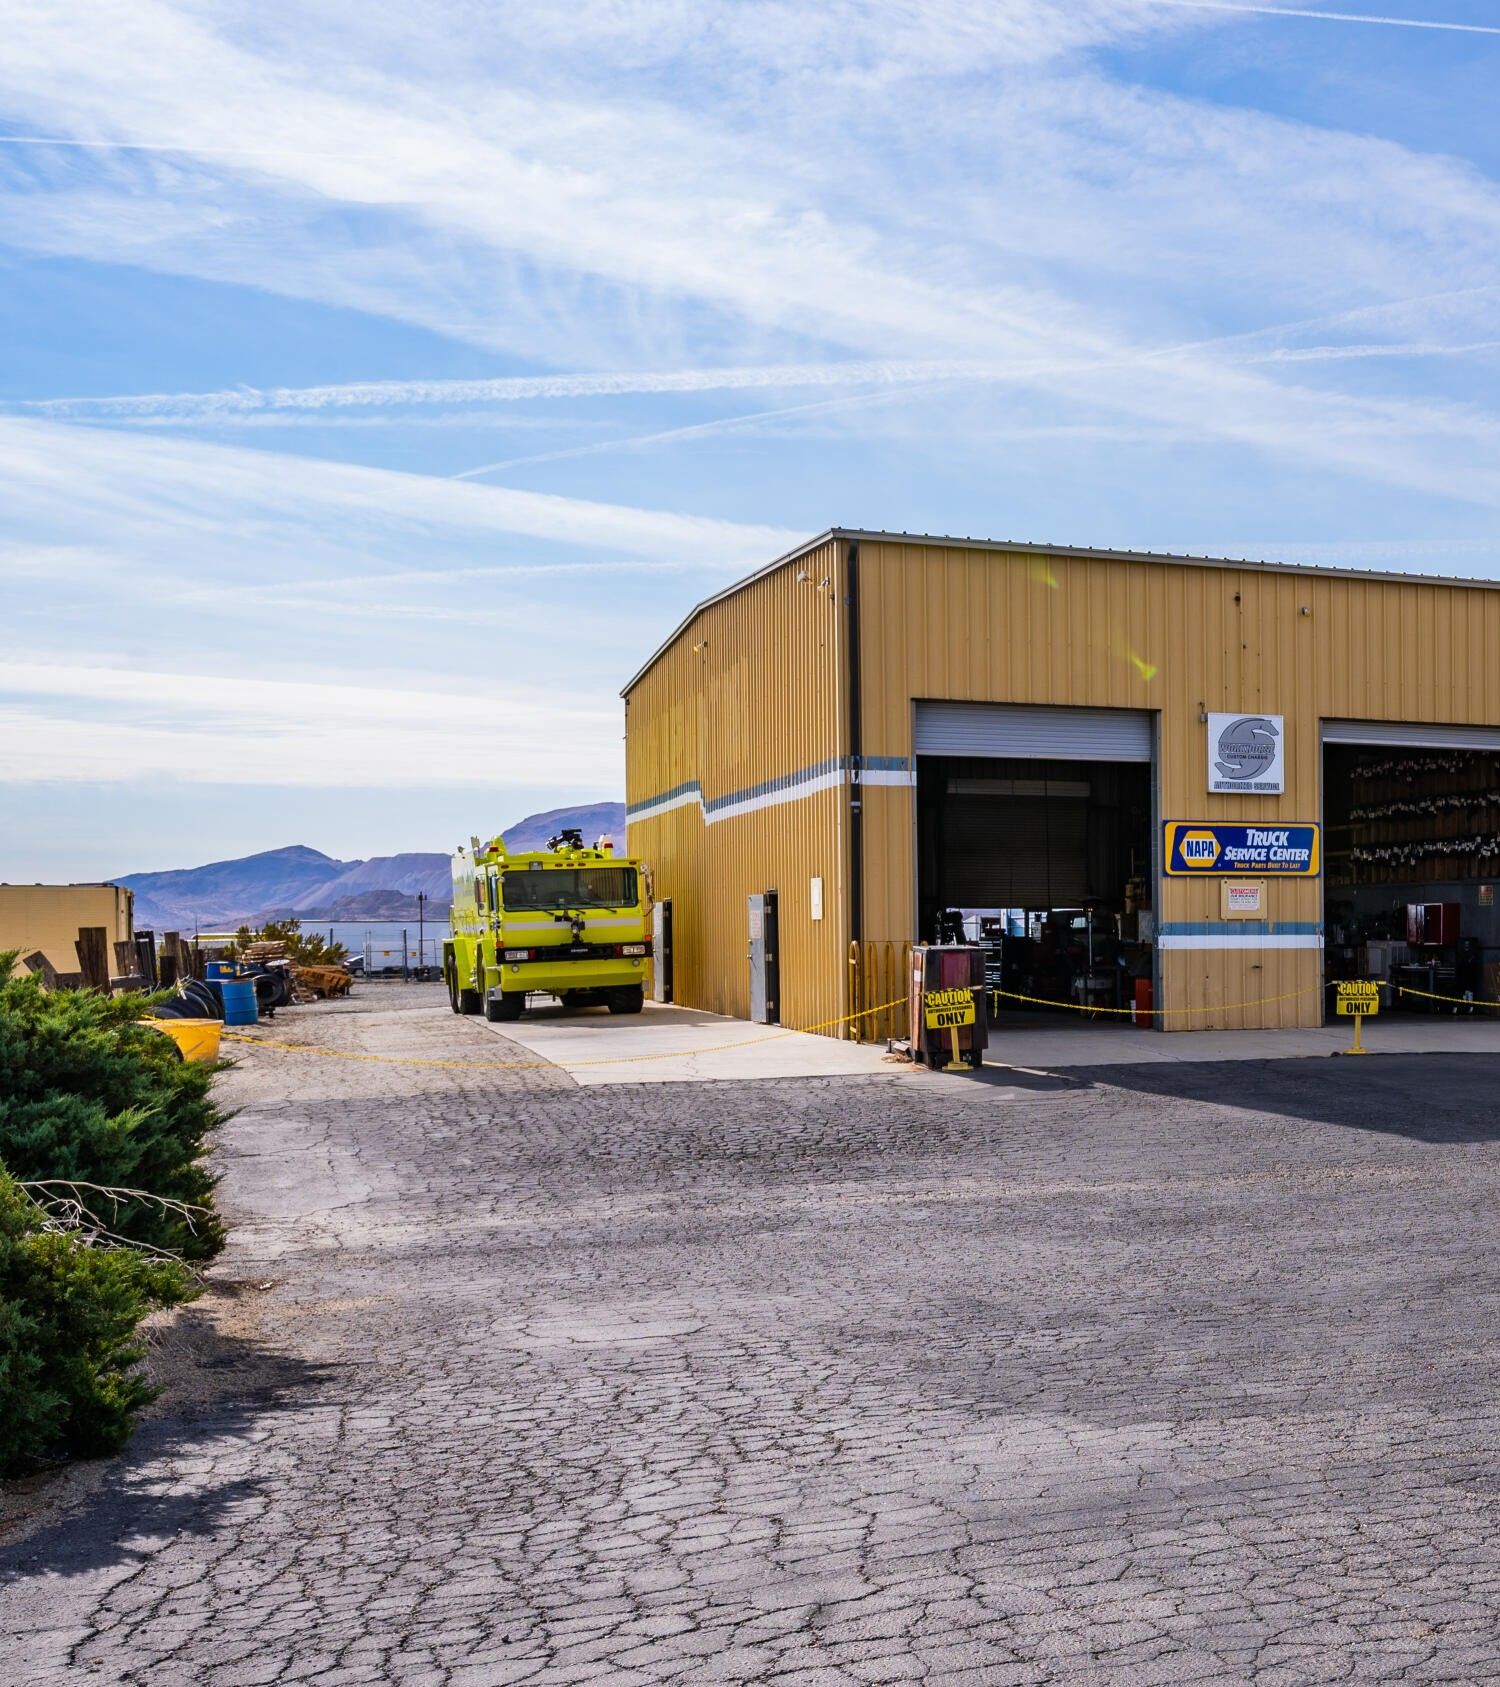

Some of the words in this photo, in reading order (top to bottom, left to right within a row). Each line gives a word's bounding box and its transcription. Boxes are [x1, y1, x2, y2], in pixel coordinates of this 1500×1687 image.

[1246, 828, 1290, 846] TRUCK
[1186, 840, 1216, 858] NAPA
[1224, 846, 1268, 861] SERVICE
[1269, 846, 1310, 861] CENTER
[1340, 983, 1377, 994] CAUTION
[927, 989, 971, 1006] CAUTION
[1346, 1002, 1371, 1013] ONLY
[937, 1011, 966, 1026] ONLY
